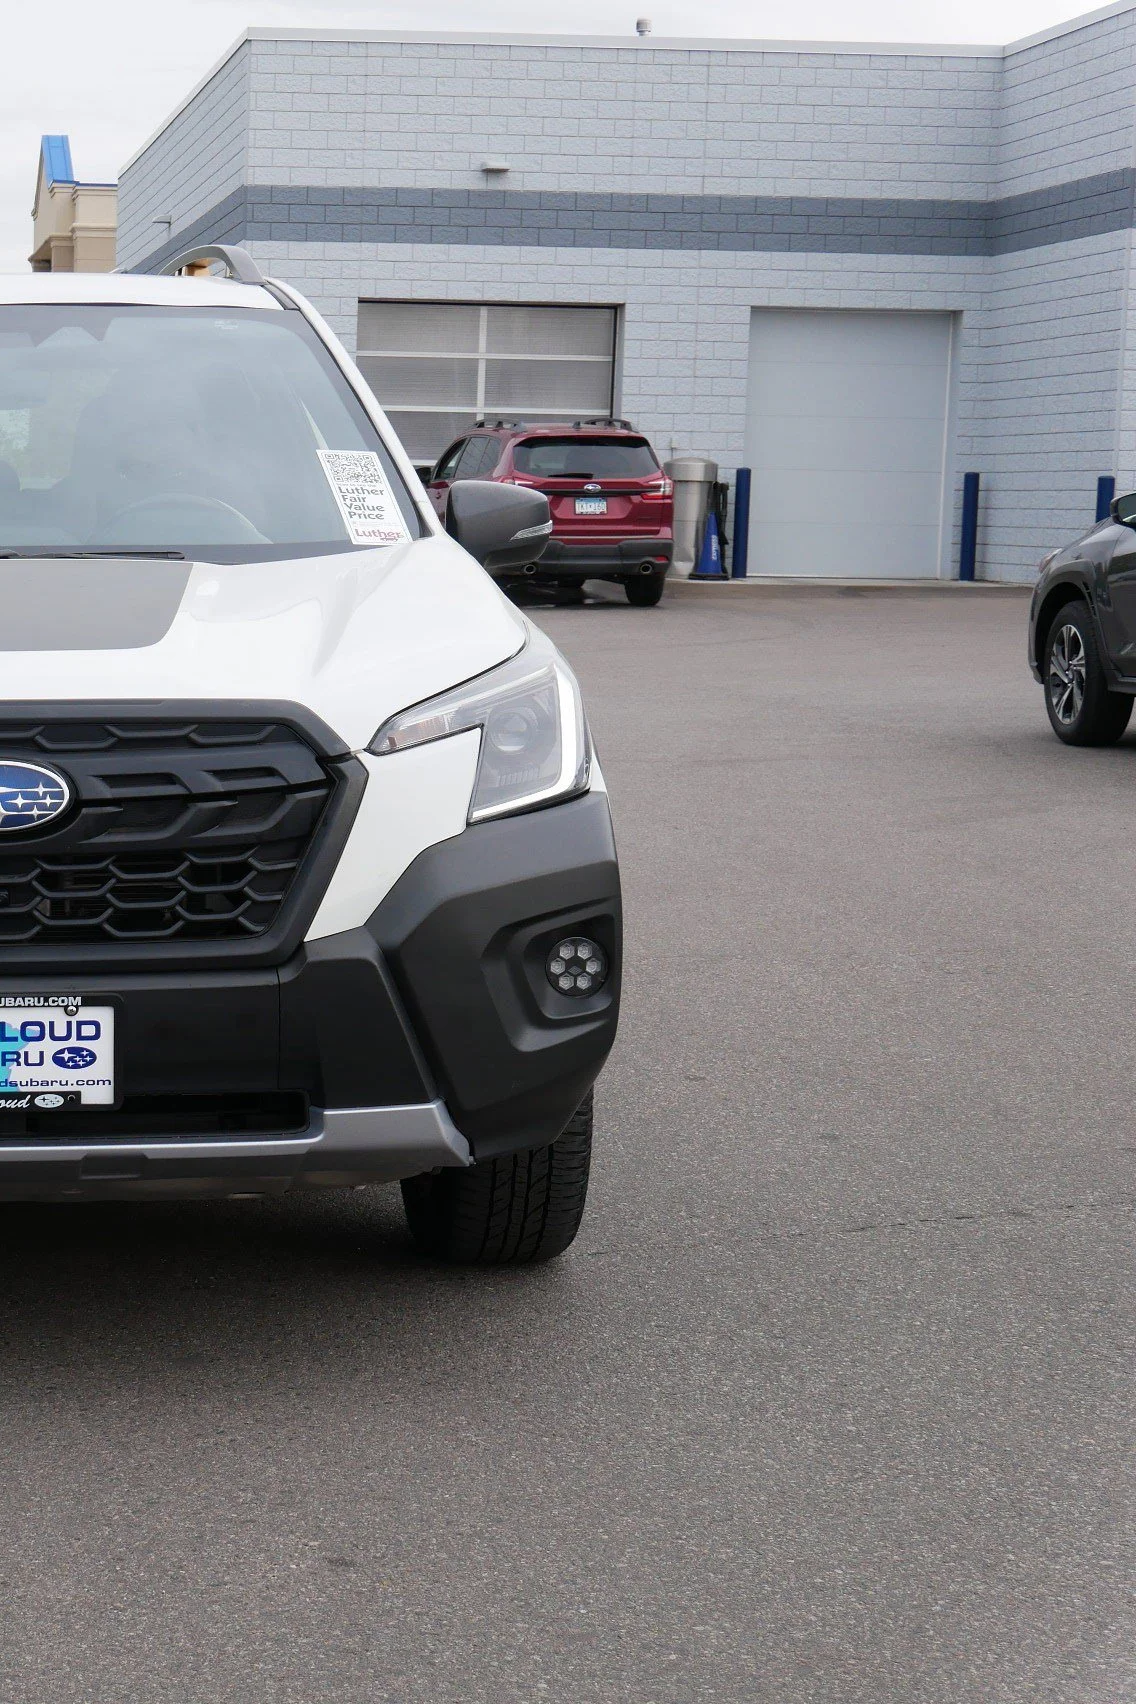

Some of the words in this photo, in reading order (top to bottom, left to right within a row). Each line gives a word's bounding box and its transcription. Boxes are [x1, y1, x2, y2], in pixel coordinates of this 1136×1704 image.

[338, 487, 384, 496] Luther
[341, 495, 366, 503] Fair
[344, 503, 384, 511] Value
[348, 511, 384, 520] Price
[355, 529, 401, 538] Luther
